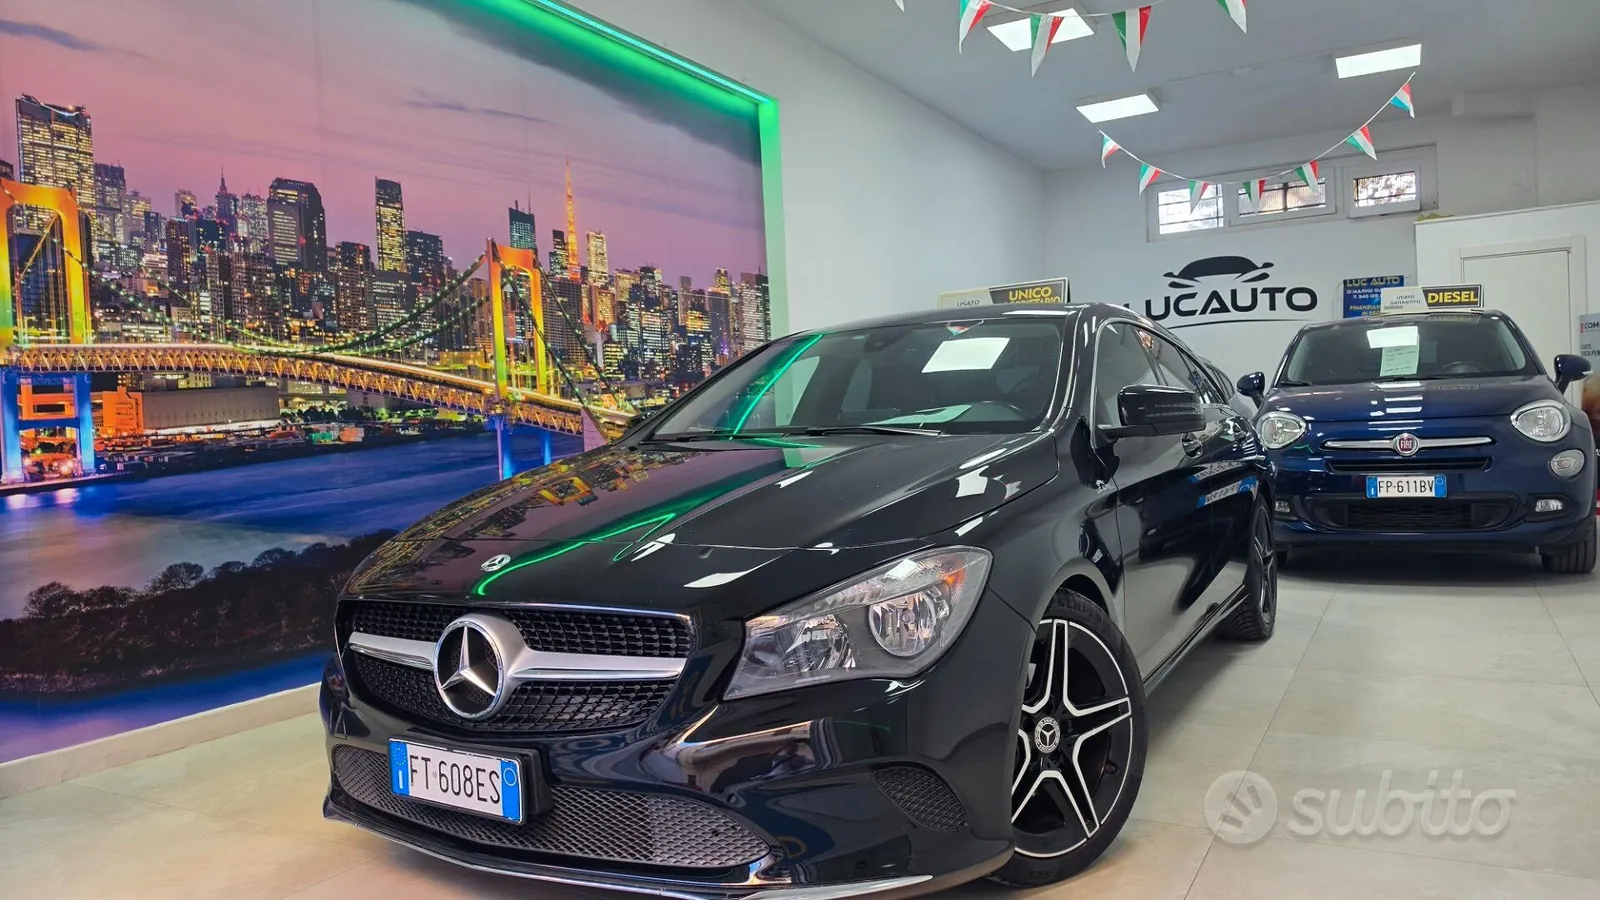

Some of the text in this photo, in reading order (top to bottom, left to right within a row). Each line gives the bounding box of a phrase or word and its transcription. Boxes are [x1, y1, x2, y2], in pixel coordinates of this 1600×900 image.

[1347, 276, 1400, 287] LUC AUTO
[1009, 286, 1052, 301] UNICO
[1427, 290, 1478, 303] DIESEL
[956, 299, 980, 307] USATO
[1124, 286, 1318, 321] UCAUTO
[1584, 321, 1600, 329] COM
[1400, 440, 1412, 449] FIAT
